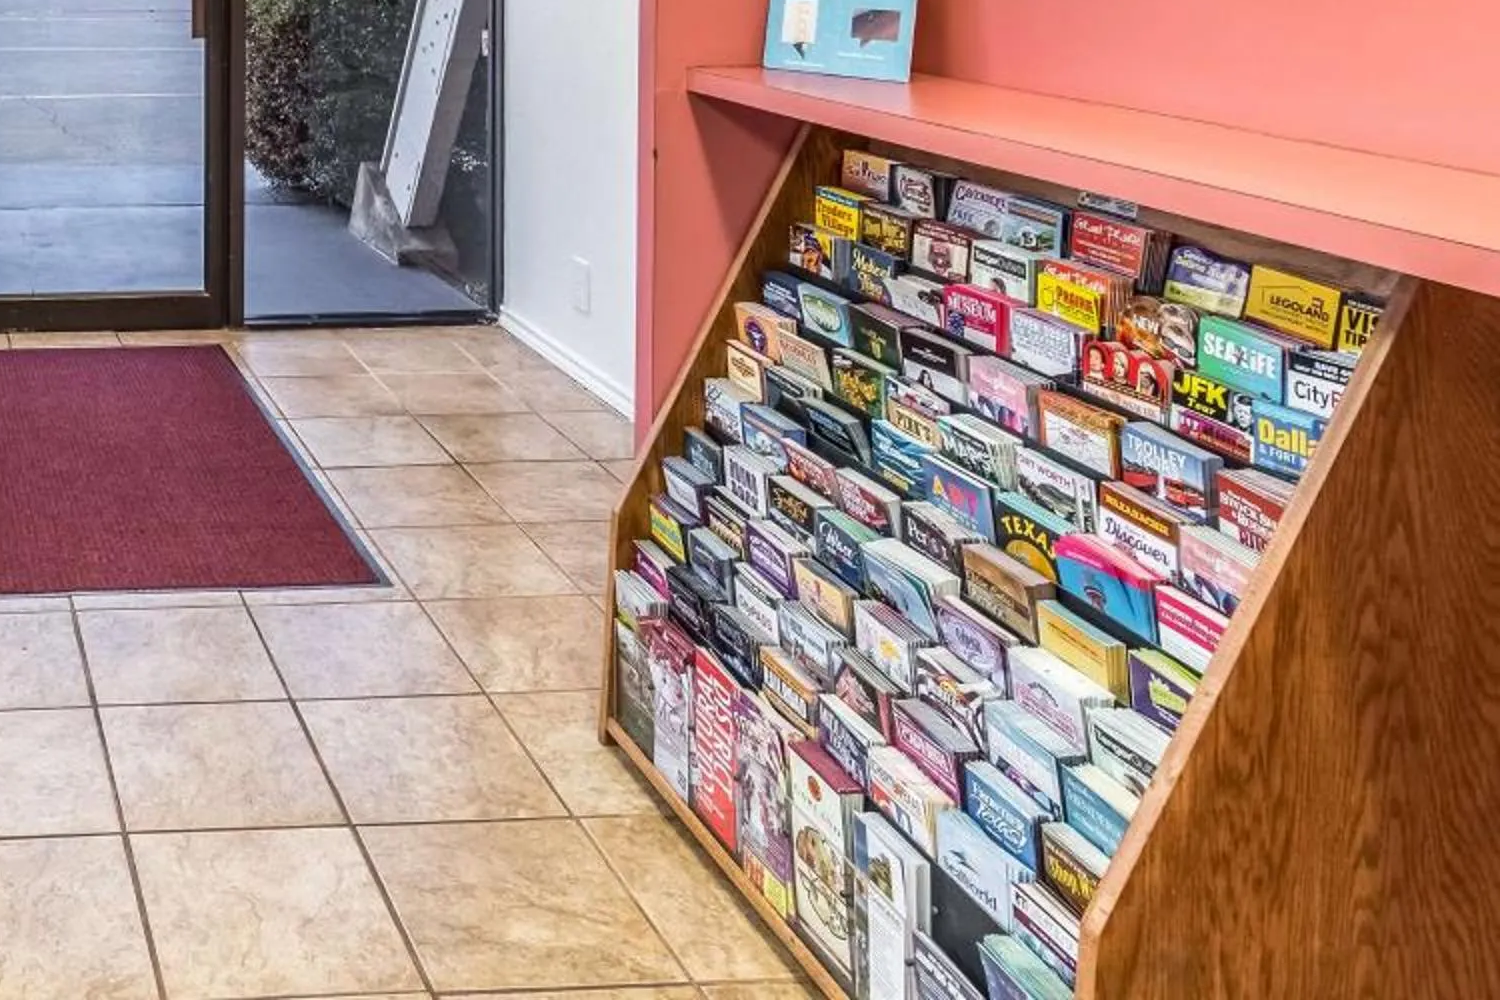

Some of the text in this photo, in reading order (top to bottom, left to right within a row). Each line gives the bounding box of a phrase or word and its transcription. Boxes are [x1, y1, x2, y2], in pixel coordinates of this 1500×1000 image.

[1269, 295, 1329, 322] LEGOLAND
[1203, 331, 1239, 366] SEA
[1173, 374, 1226, 410] JFK
[1127, 433, 1187, 470] TROLLEY
[1105, 517, 1170, 567] Discover
